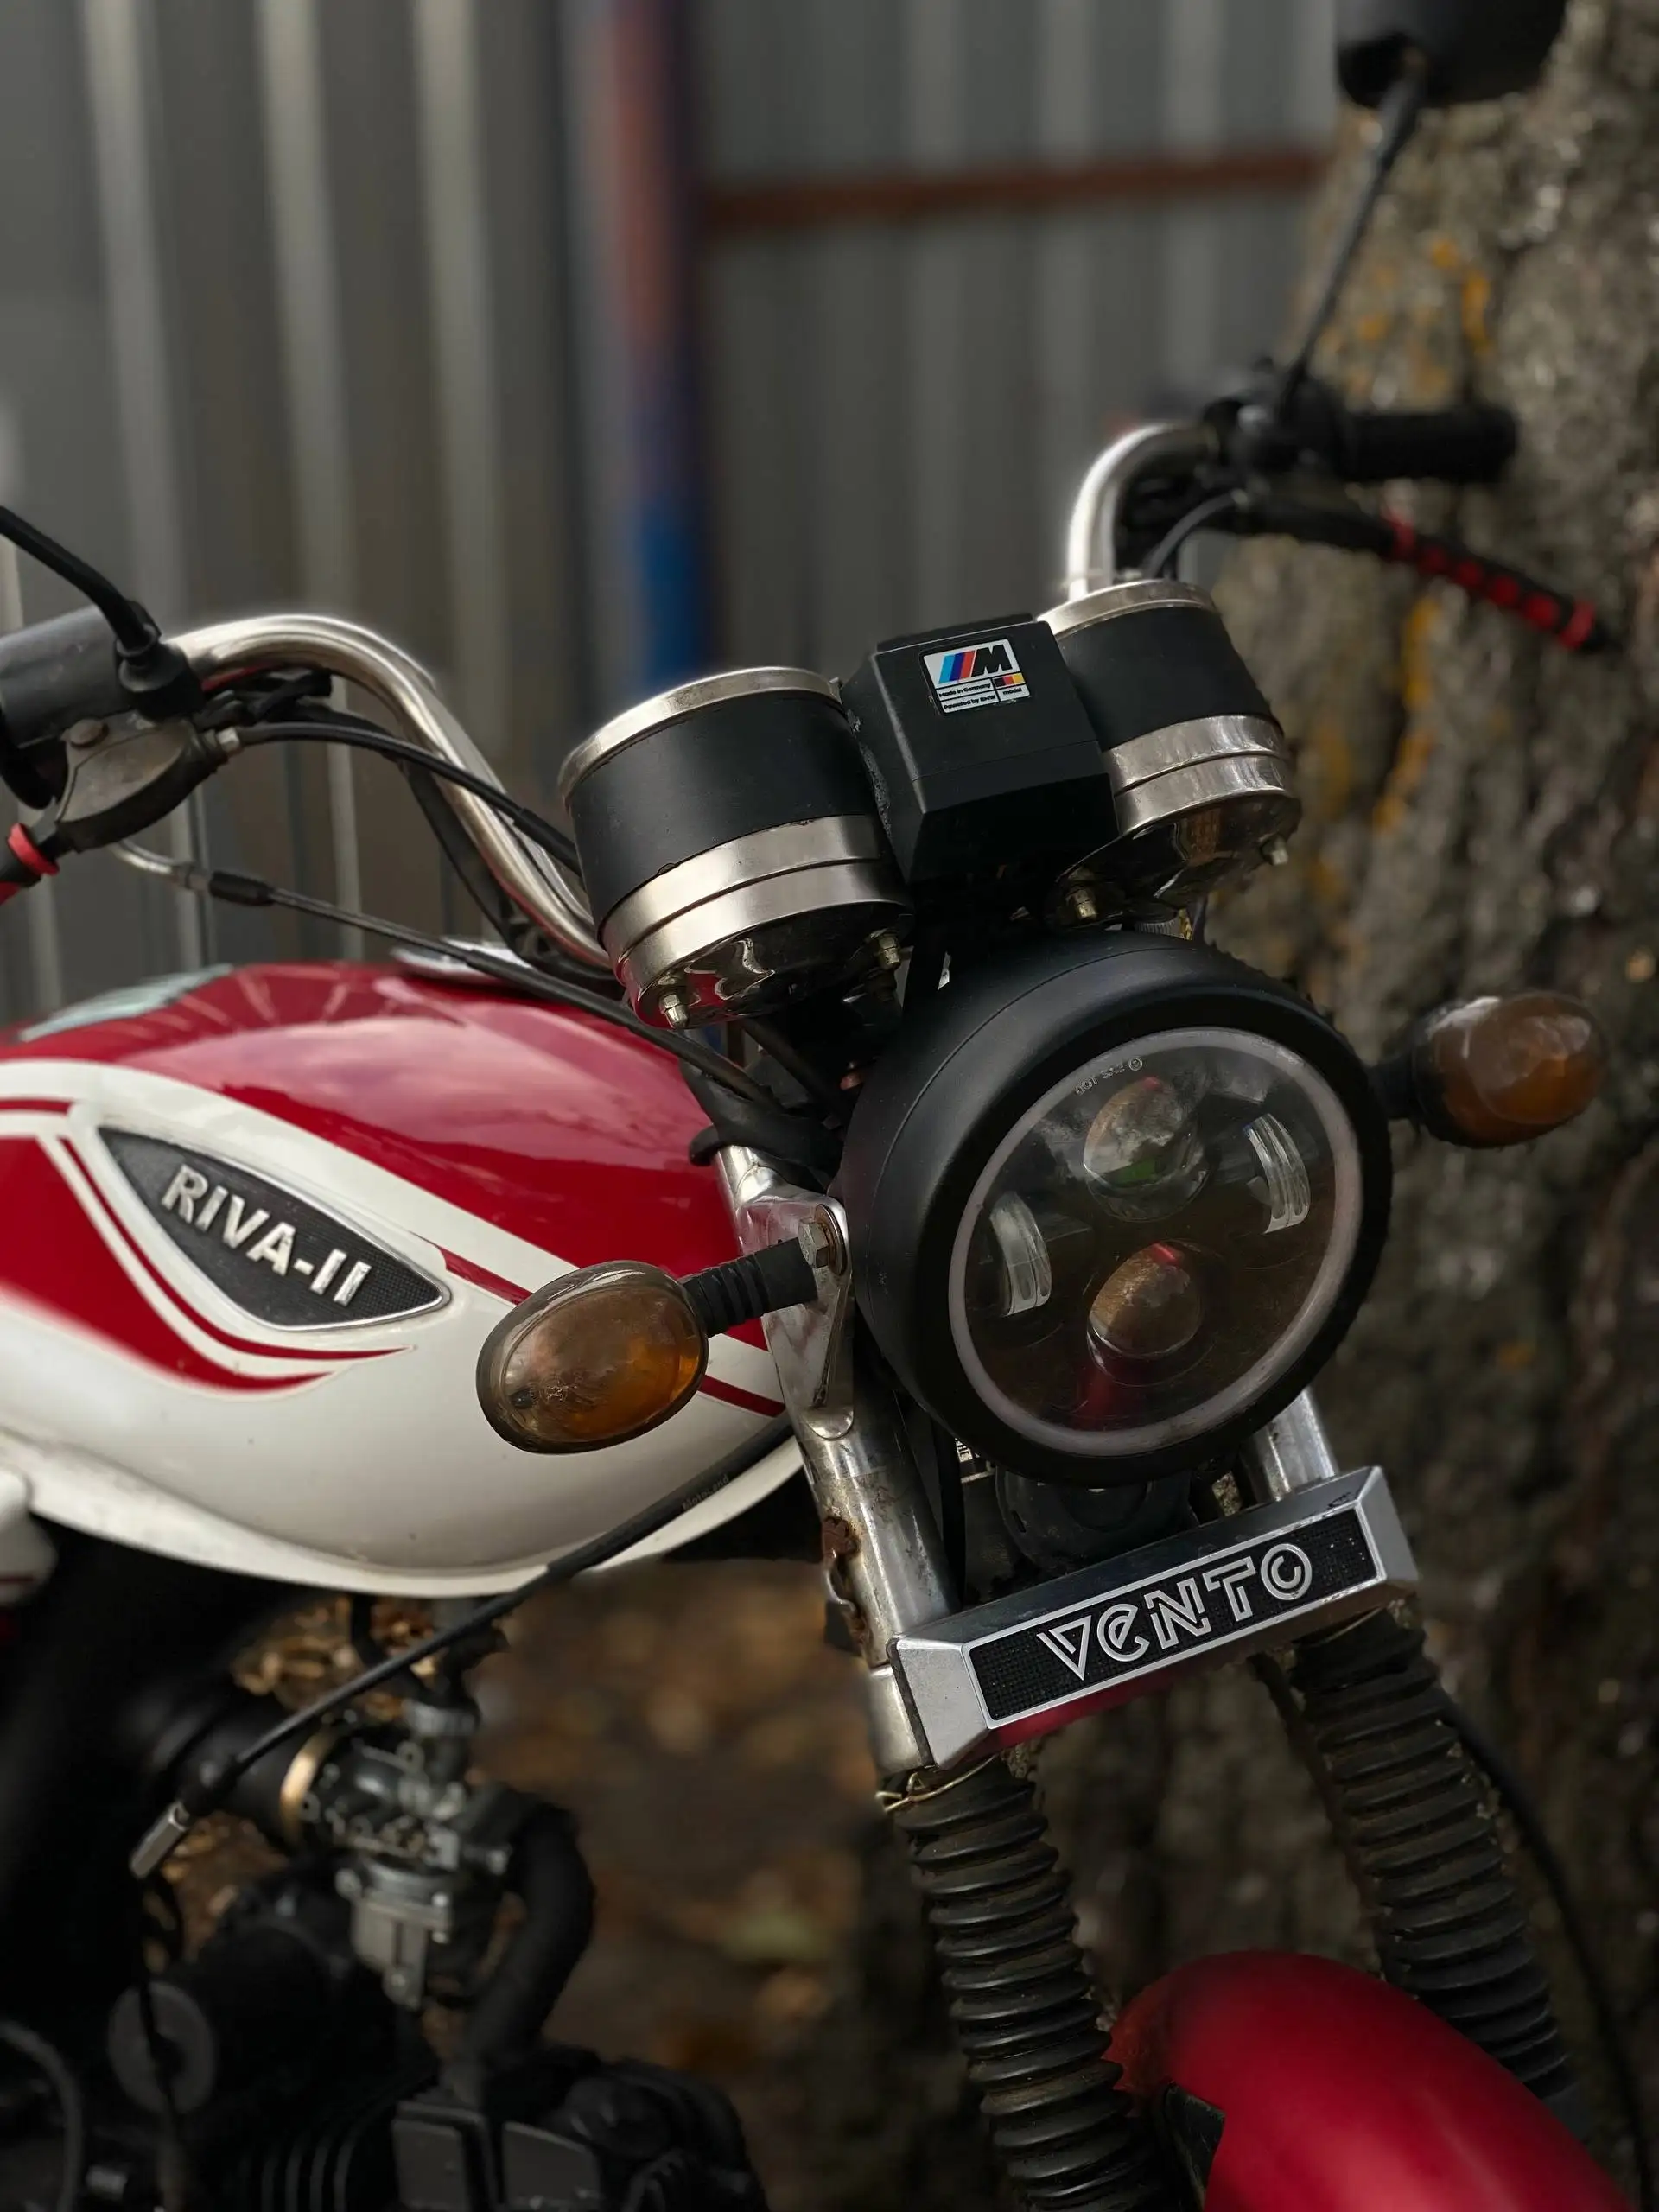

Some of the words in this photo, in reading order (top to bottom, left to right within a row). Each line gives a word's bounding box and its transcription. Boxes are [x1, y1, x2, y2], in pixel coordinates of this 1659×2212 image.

[963, 683, 991, 692] Germany
[944, 699, 971, 709] Powered
[161, 1163, 372, 1306] RIVA-II
